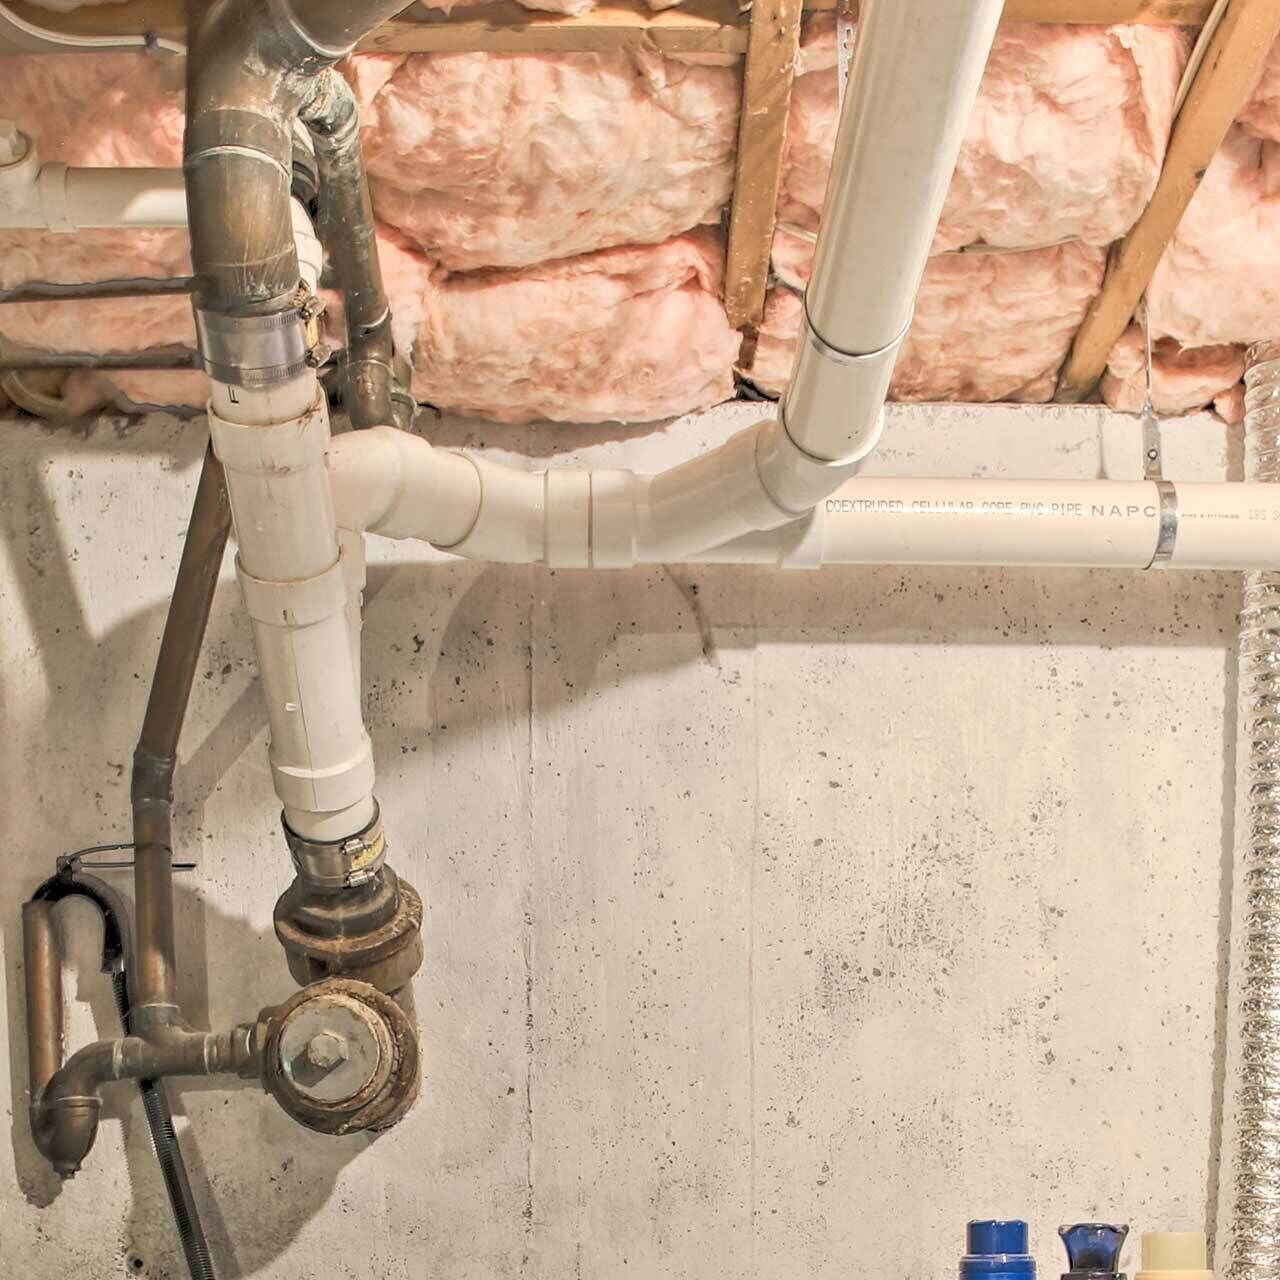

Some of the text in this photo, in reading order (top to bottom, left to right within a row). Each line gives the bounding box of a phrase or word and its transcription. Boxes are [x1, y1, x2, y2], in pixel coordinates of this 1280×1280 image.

[825, 499, 904, 513] COEXTRUDED
[911, 500, 974, 514] CELLULAR
[981, 501, 1013, 515] CORE
[1020, 502, 1045, 516] PVC
[1051, 502, 1082, 516] PIPE
[1091, 504, 1157, 518] NAPC
